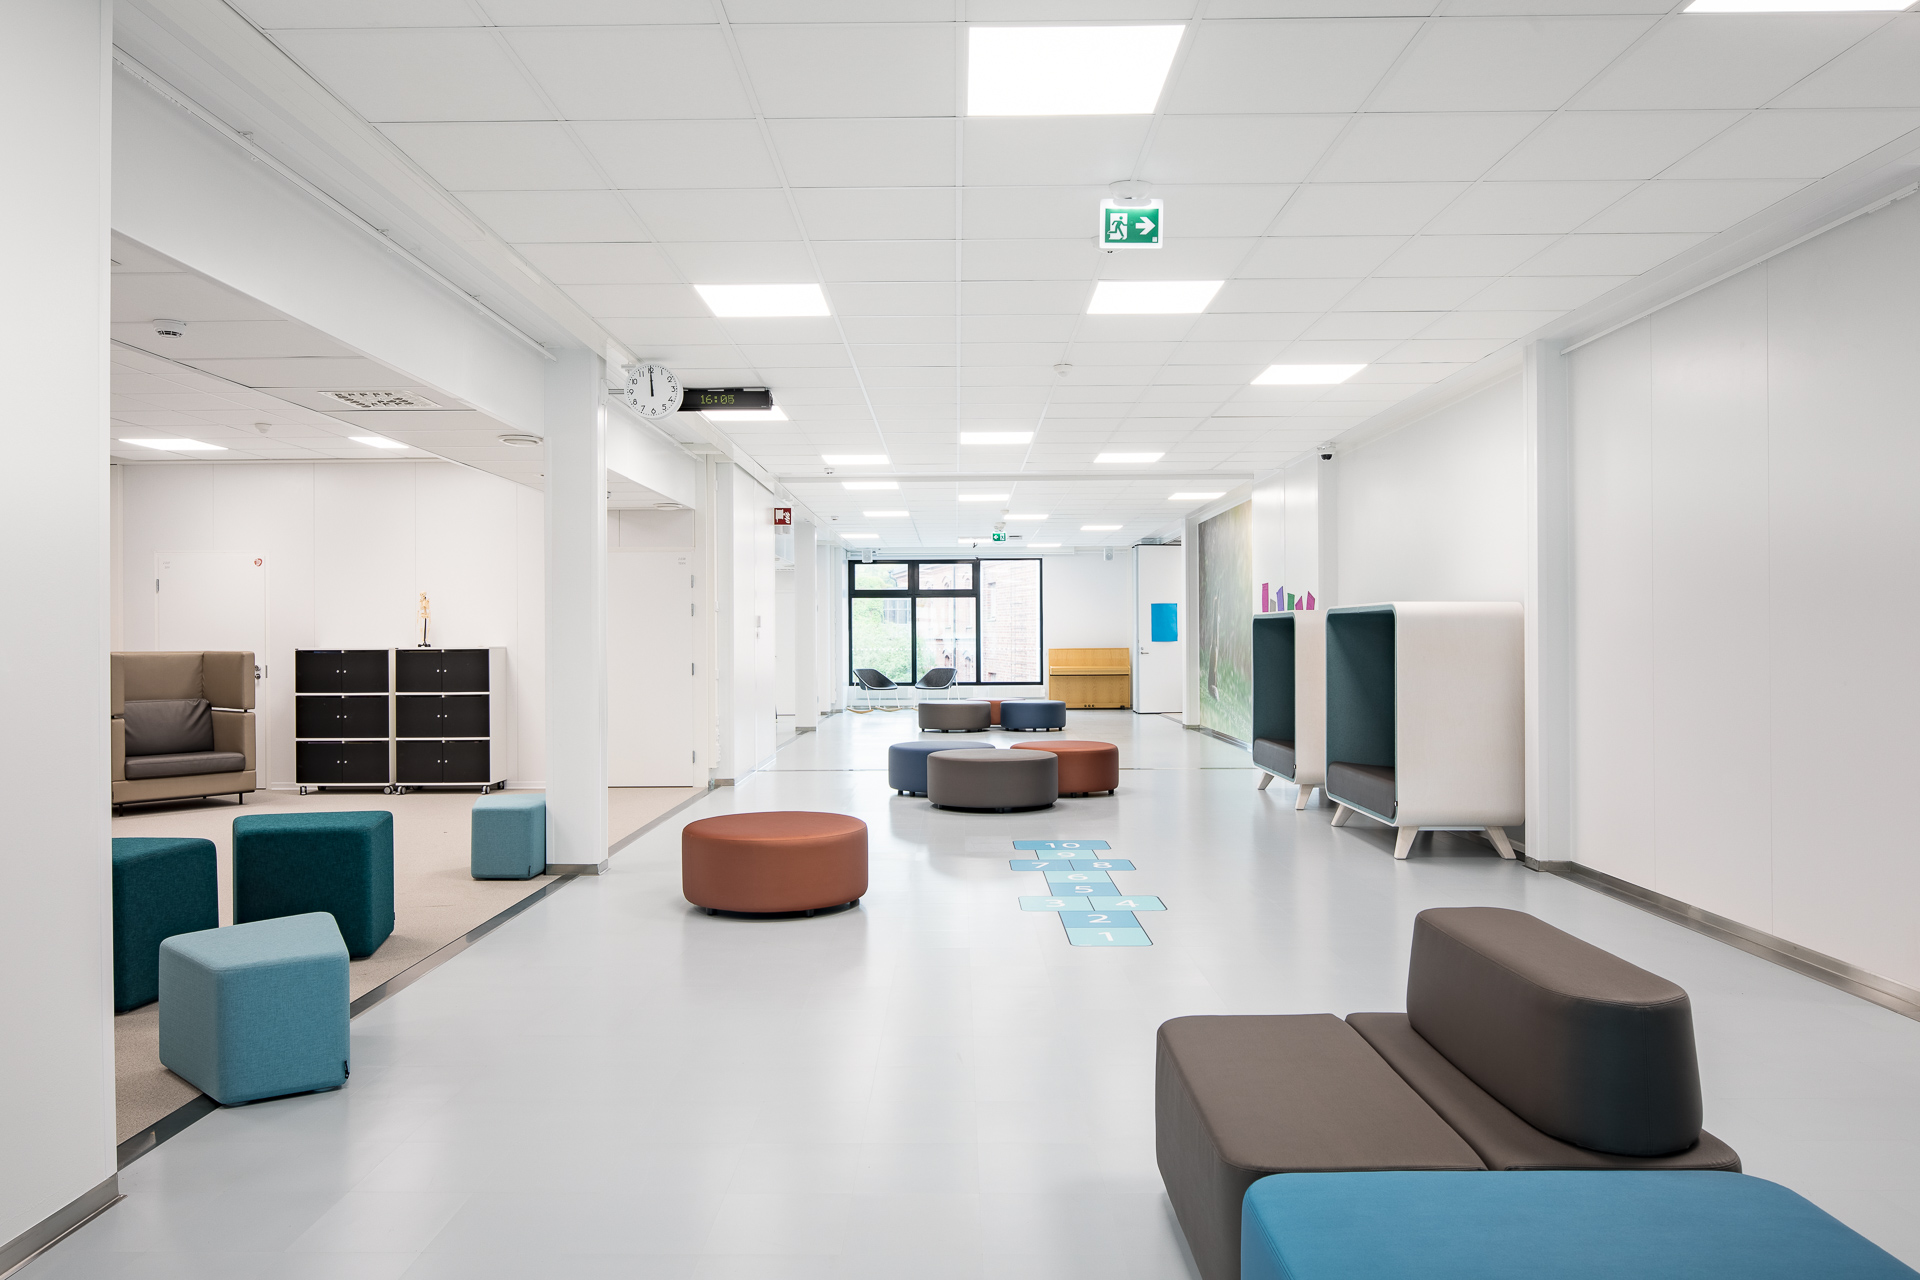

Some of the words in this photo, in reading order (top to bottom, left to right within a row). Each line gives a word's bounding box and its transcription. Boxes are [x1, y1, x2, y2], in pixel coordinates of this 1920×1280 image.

[638, 370, 645, 378] 11
[667, 375, 673, 383] 2
[671, 385, 676, 393] 3
[700, 394, 735, 405] 16:05
[641, 404, 646, 412] 7
[650, 407, 656, 415] 6
[662, 403, 667, 411] 5
[1031, 861, 1050, 869] 7
[1092, 861, 1113, 869] 8
[1067, 873, 1089, 881] 6
[1074, 885, 1094, 894] 5
[1044, 899, 1066, 908] 3
[1115, 899, 1140, 908] 4
[1087, 914, 1112, 924] 2
[1098, 931, 1114, 942] 1
